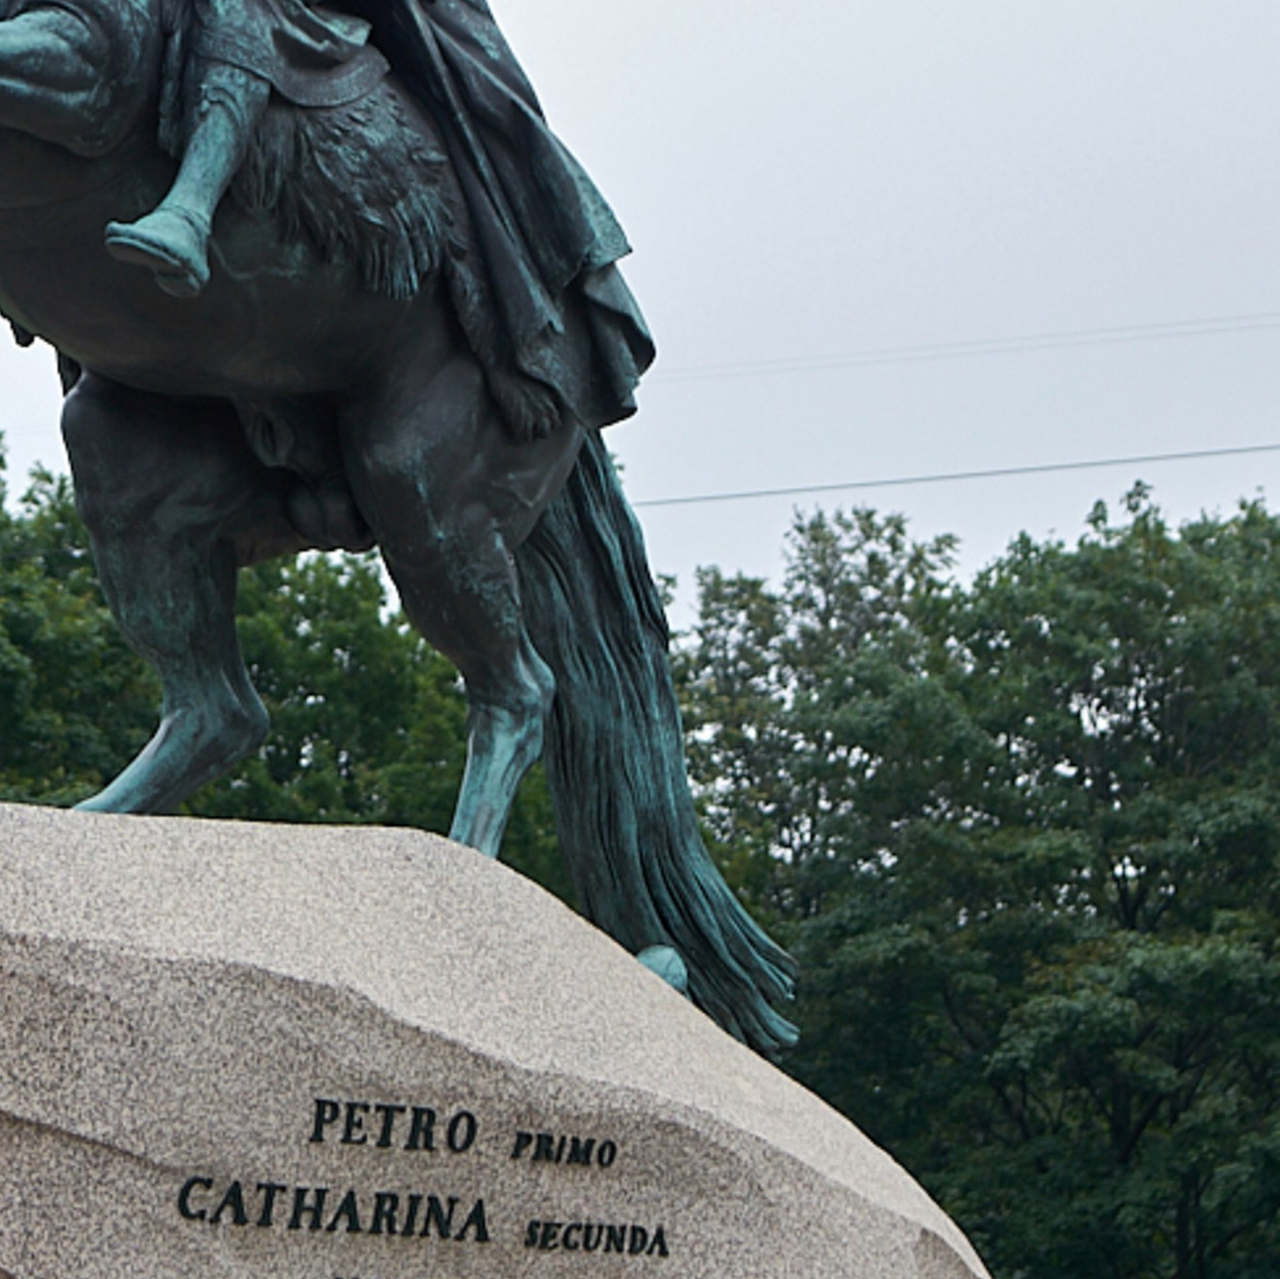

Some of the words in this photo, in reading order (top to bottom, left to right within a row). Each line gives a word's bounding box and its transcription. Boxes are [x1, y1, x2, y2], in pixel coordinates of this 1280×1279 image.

[308, 1098, 478, 1153] PETRO
[509, 1130, 618, 1169] PRIMO
[176, 1176, 491, 1243] CATHARINA
[523, 1219, 670, 1257] SECUNDA
